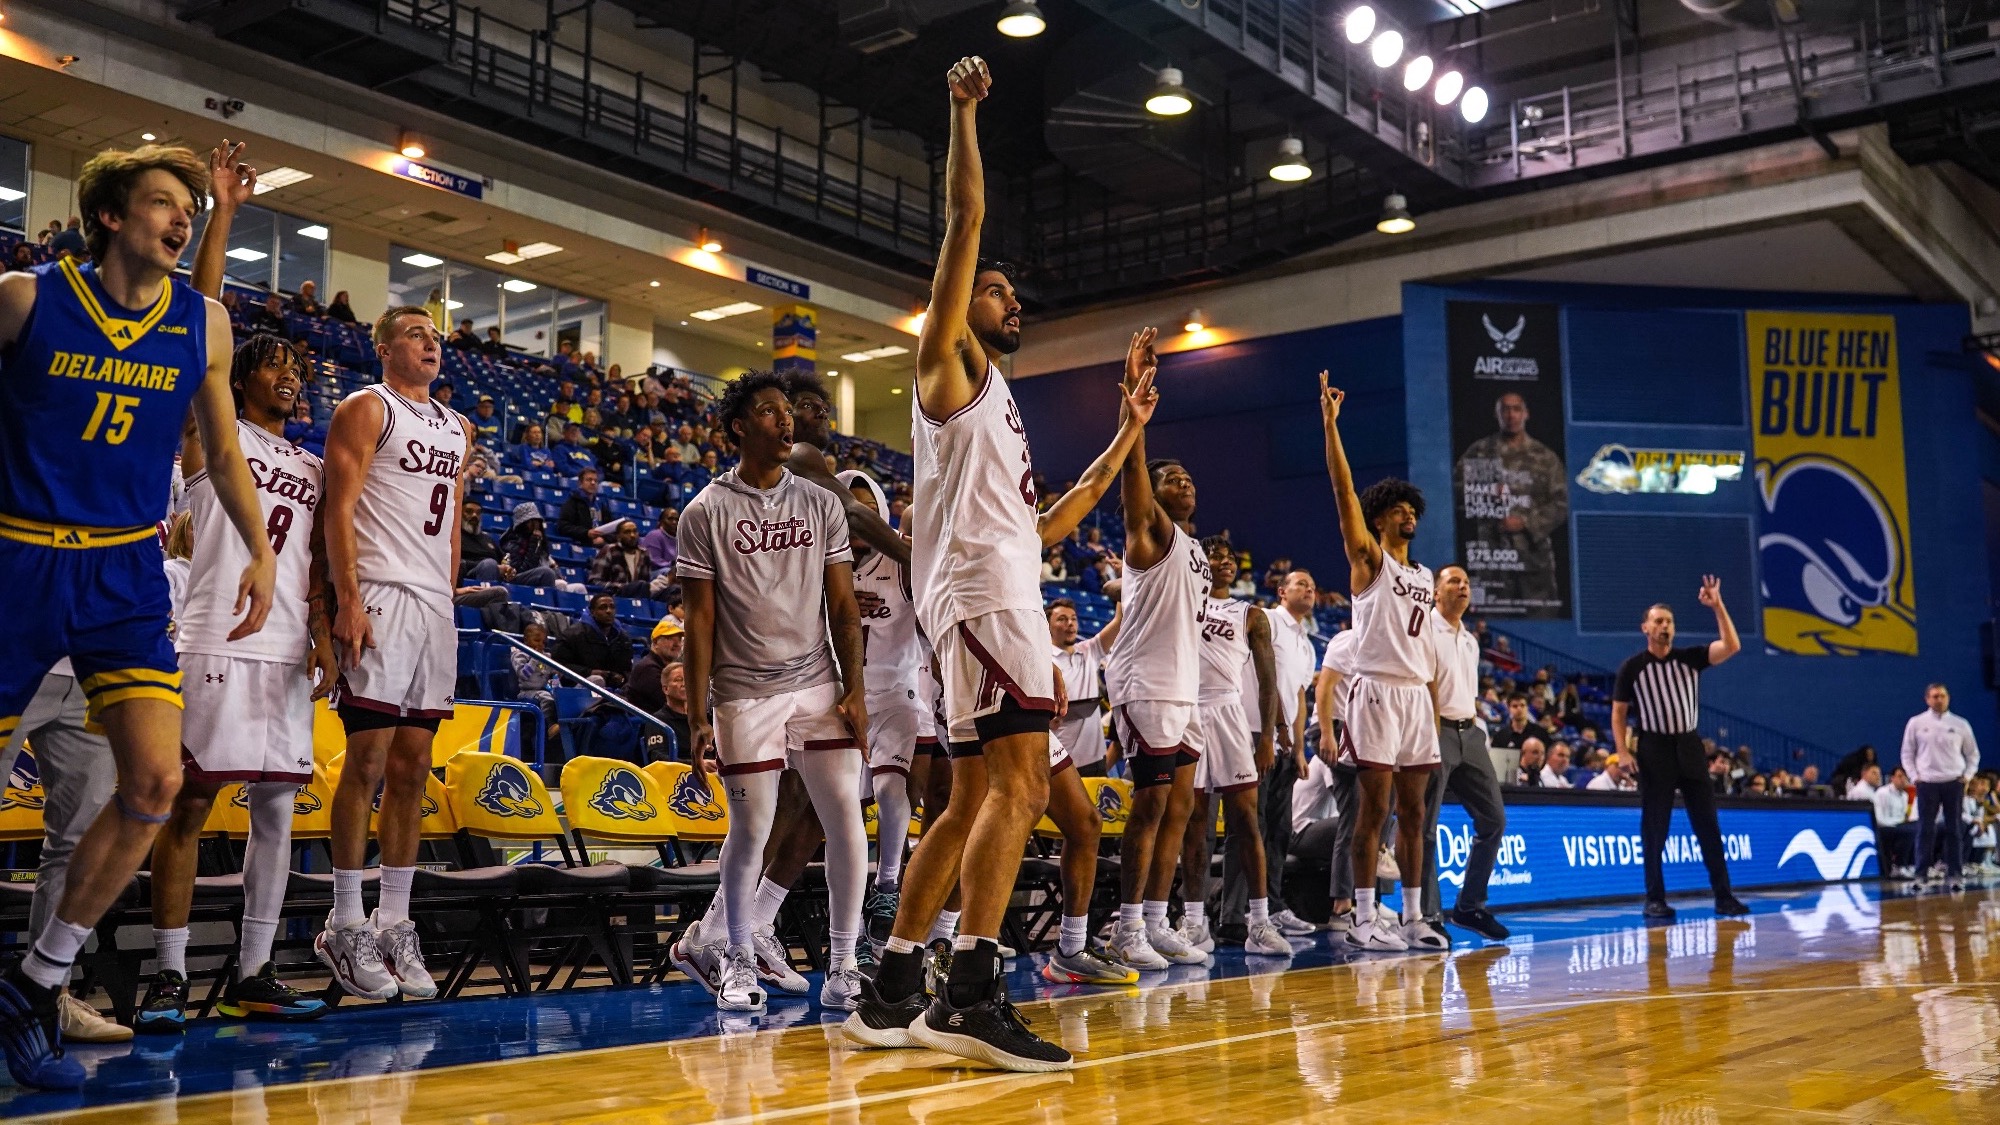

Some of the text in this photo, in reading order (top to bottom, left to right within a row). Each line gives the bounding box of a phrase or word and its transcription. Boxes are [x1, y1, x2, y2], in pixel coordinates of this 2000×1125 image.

[1474, 356, 1502, 374] AIR
[1765, 328, 1889, 368] BLUE HEN
[48, 351, 180, 392] DELAWARE
[81, 391, 141, 445] 15
[1760, 370, 1888, 438] BUILT
[266, 504, 294, 556] 8
[424, 483, 449, 537] 9
[778, 521, 804, 529] MEXICO
[733, 515, 815, 555] State
[1408, 605, 1424, 637] 0
